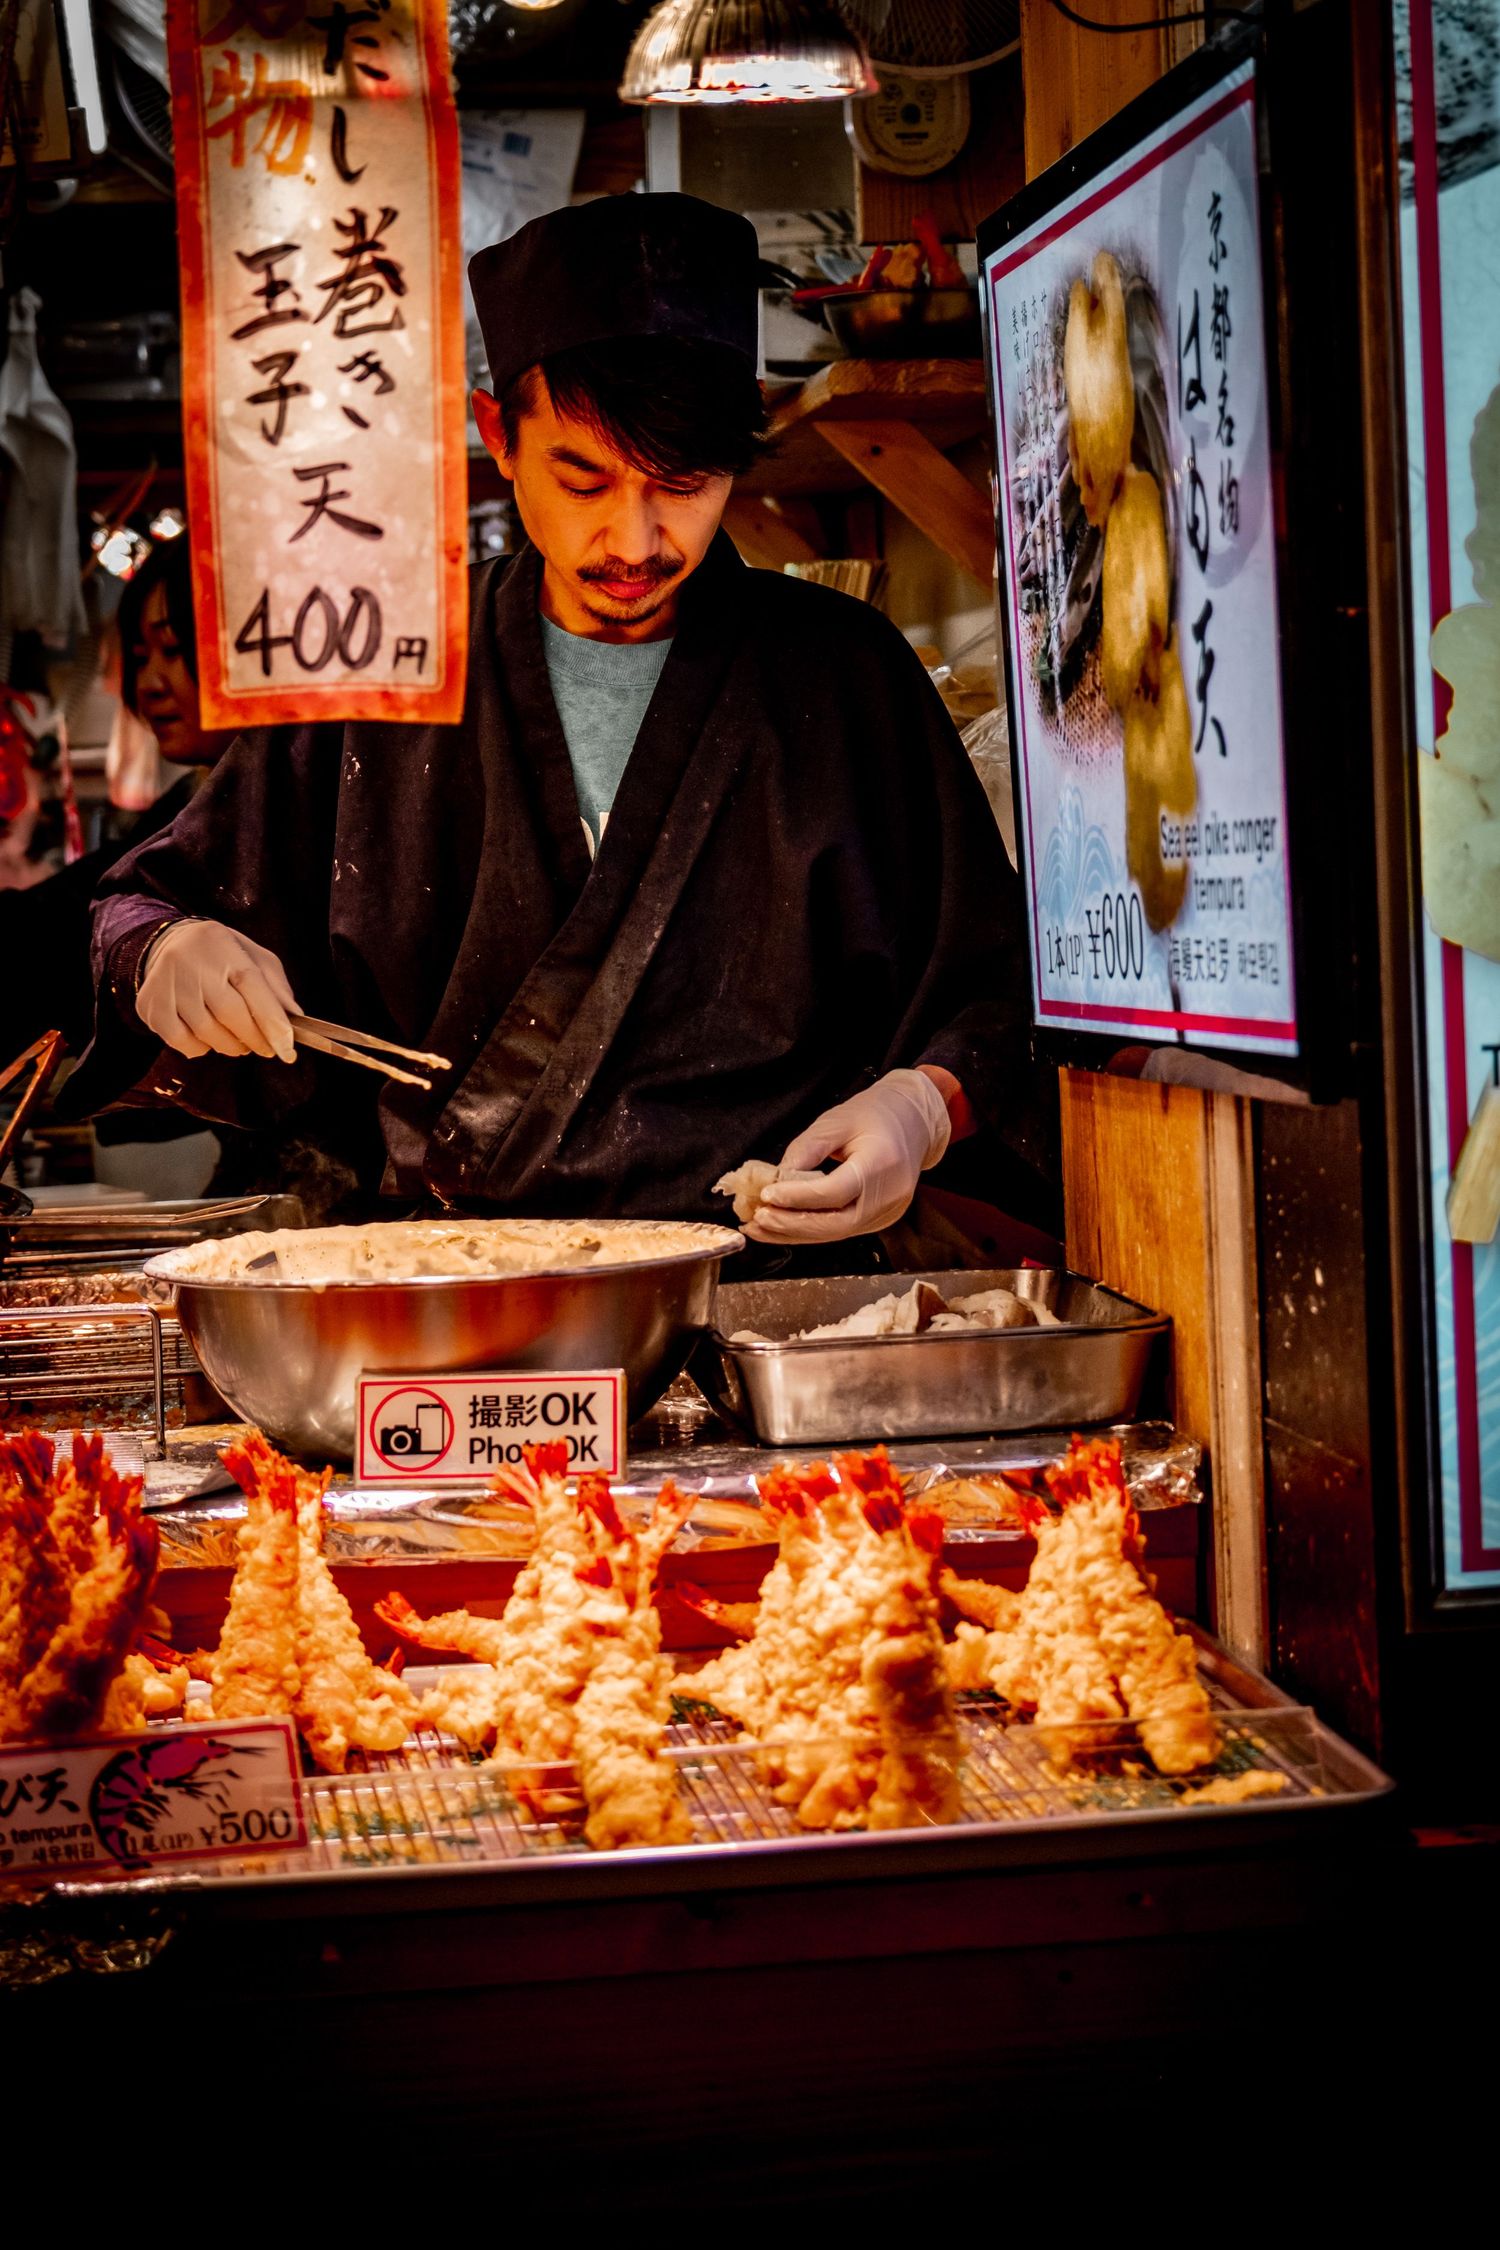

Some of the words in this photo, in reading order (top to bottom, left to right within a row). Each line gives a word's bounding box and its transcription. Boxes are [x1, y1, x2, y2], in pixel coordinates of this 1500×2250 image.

[1207, 191, 1240, 536] 京都名物
[235, 585, 428, 677] 400円
[1160, 814, 1182, 859] Sea
[1204, 811, 1229, 867] pike
[1232, 815, 1277, 863] conger
[1194, 872, 1244, 921] tempura
[1085, 892, 1144, 981] ¥600
[469, 1392, 598, 1429] 撮影OK
[469, 1435, 548, 1465] Pho
[11, 1822, 92, 1846] tempura
[199, 1808, 292, 1846] ¥500
